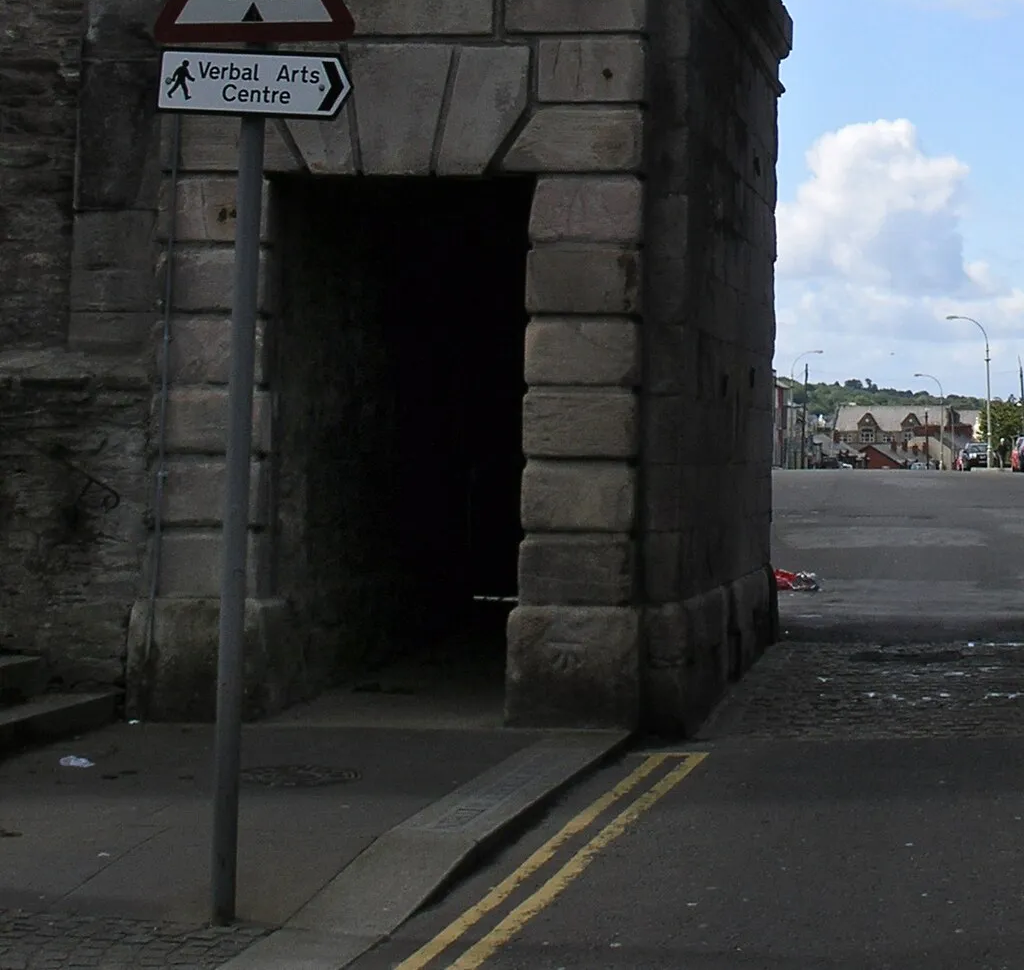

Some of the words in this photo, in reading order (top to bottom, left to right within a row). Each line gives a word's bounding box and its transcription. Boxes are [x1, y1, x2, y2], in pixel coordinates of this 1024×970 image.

[198, 61, 260, 82] Verbal
[275, 64, 320, 84] Arts
[222, 83, 291, 105] Centre
